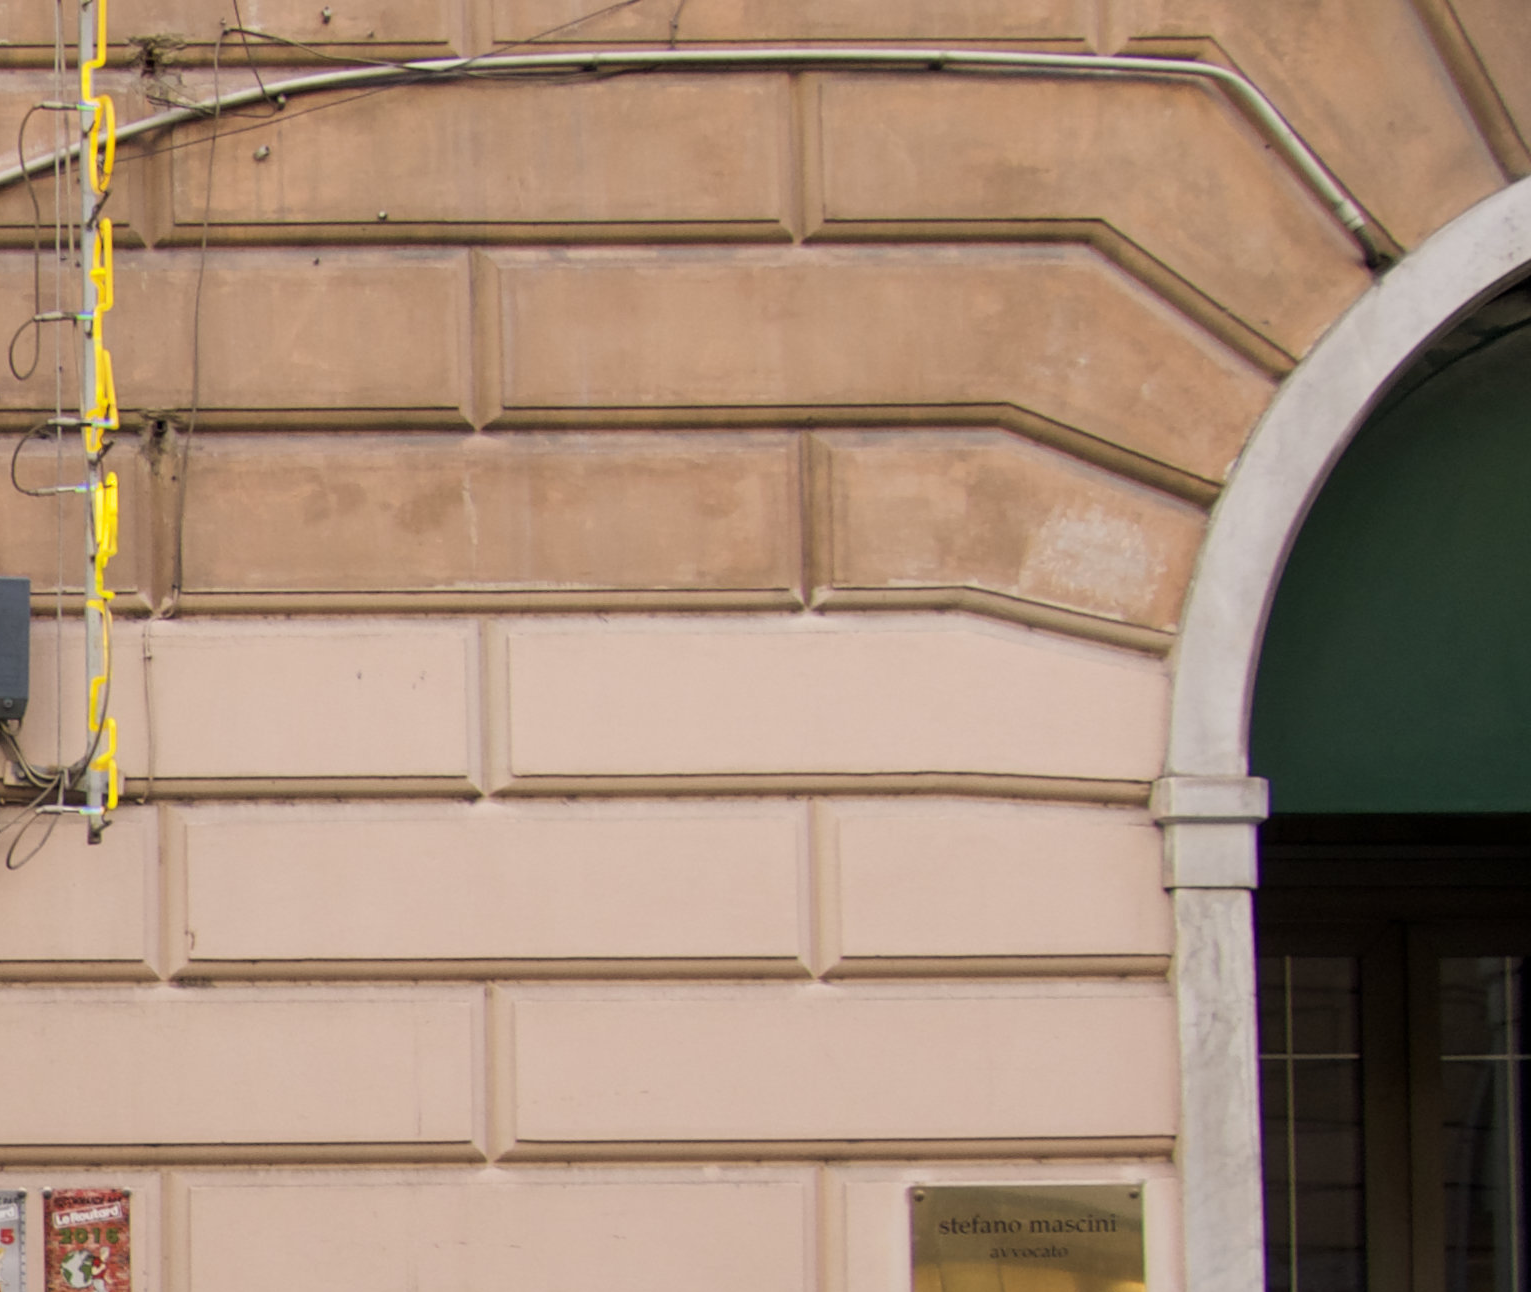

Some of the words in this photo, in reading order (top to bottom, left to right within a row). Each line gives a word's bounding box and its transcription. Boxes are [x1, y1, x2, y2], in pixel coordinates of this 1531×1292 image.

[70, 1206, 119, 1223] Routard
[939, 1214, 1022, 1235] stefano
[1029, 1213, 1117, 1233] mascini
[59, 1228, 119, 1244] 2016
[990, 1244, 1069, 1259] avvocato
